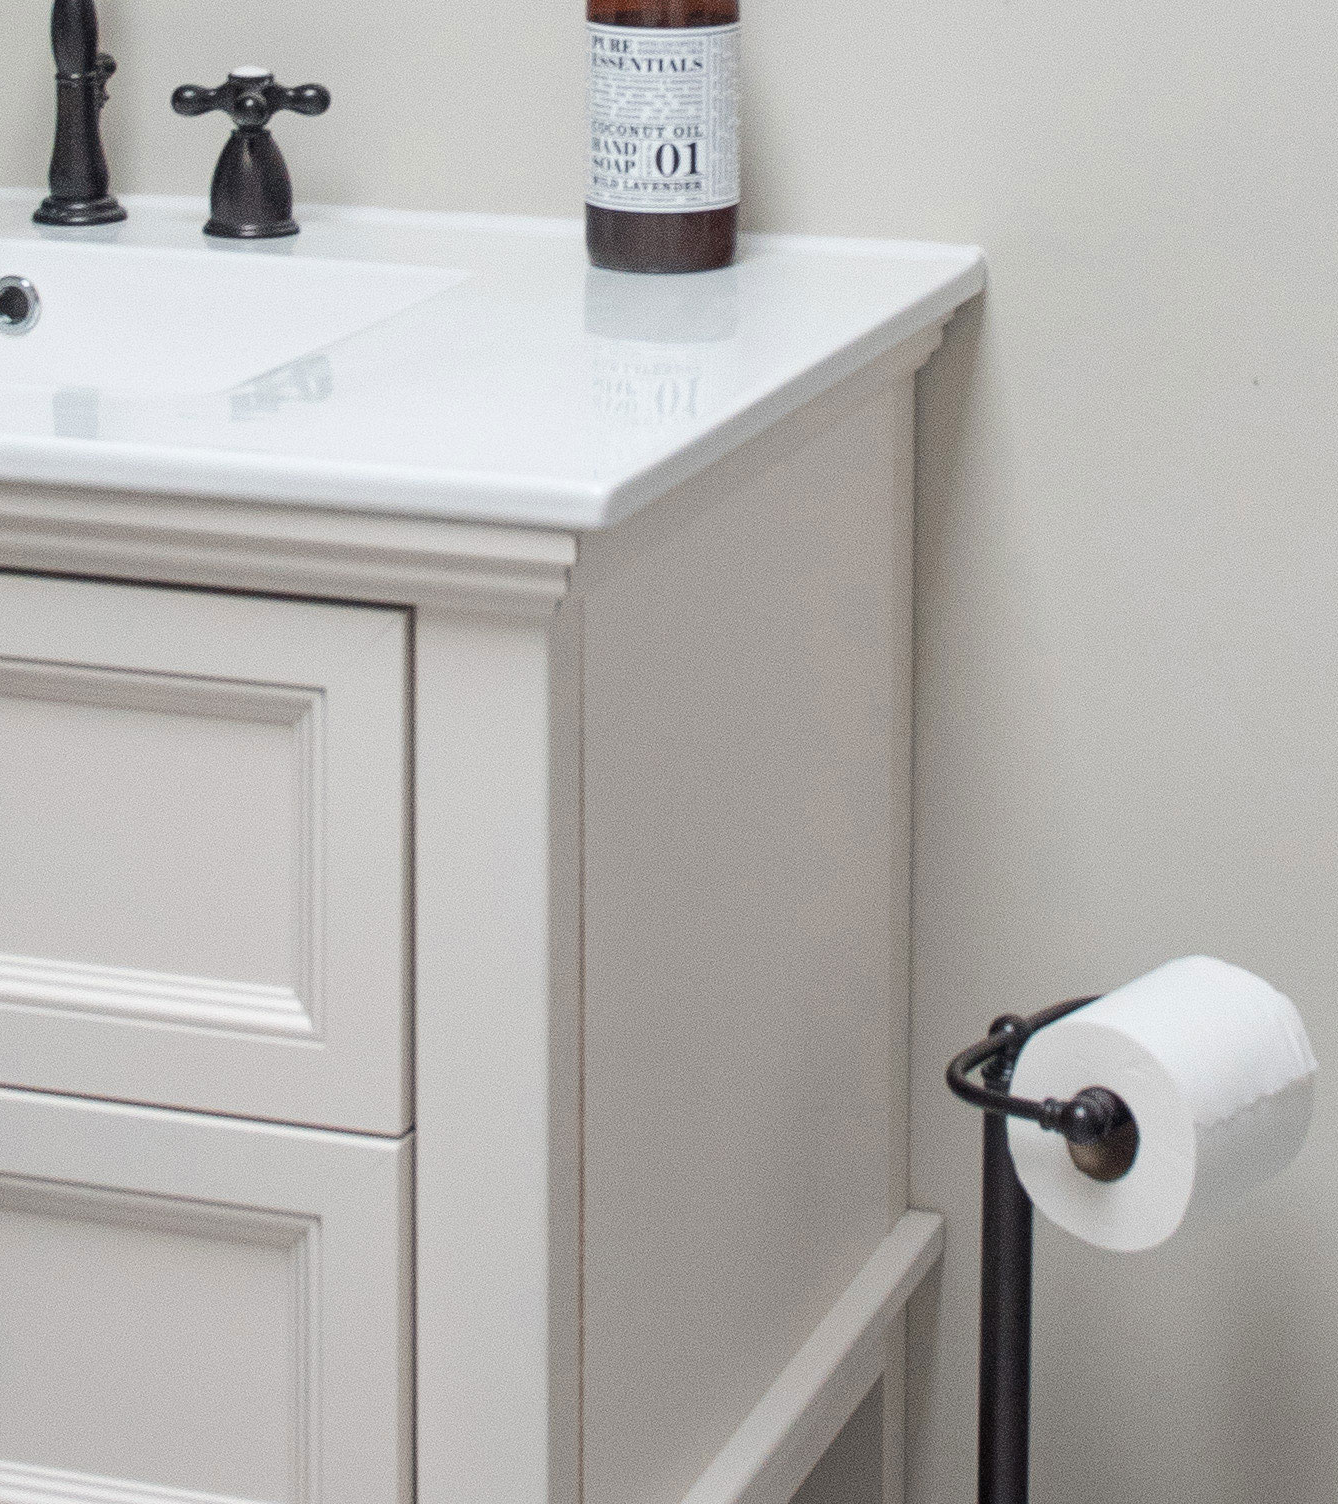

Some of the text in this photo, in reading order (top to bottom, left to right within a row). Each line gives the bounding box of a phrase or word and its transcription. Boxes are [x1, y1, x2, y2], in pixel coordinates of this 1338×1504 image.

[592, 36, 633, 53] PURE
[591, 52, 704, 72] ESSENTIALS
[673, 125, 703, 138] OIL
[592, 138, 637, 156] HAND
[593, 156, 635, 173] SOAP
[655, 142, 702, 177] 01
[624, 180, 702, 192] LAVENDER
